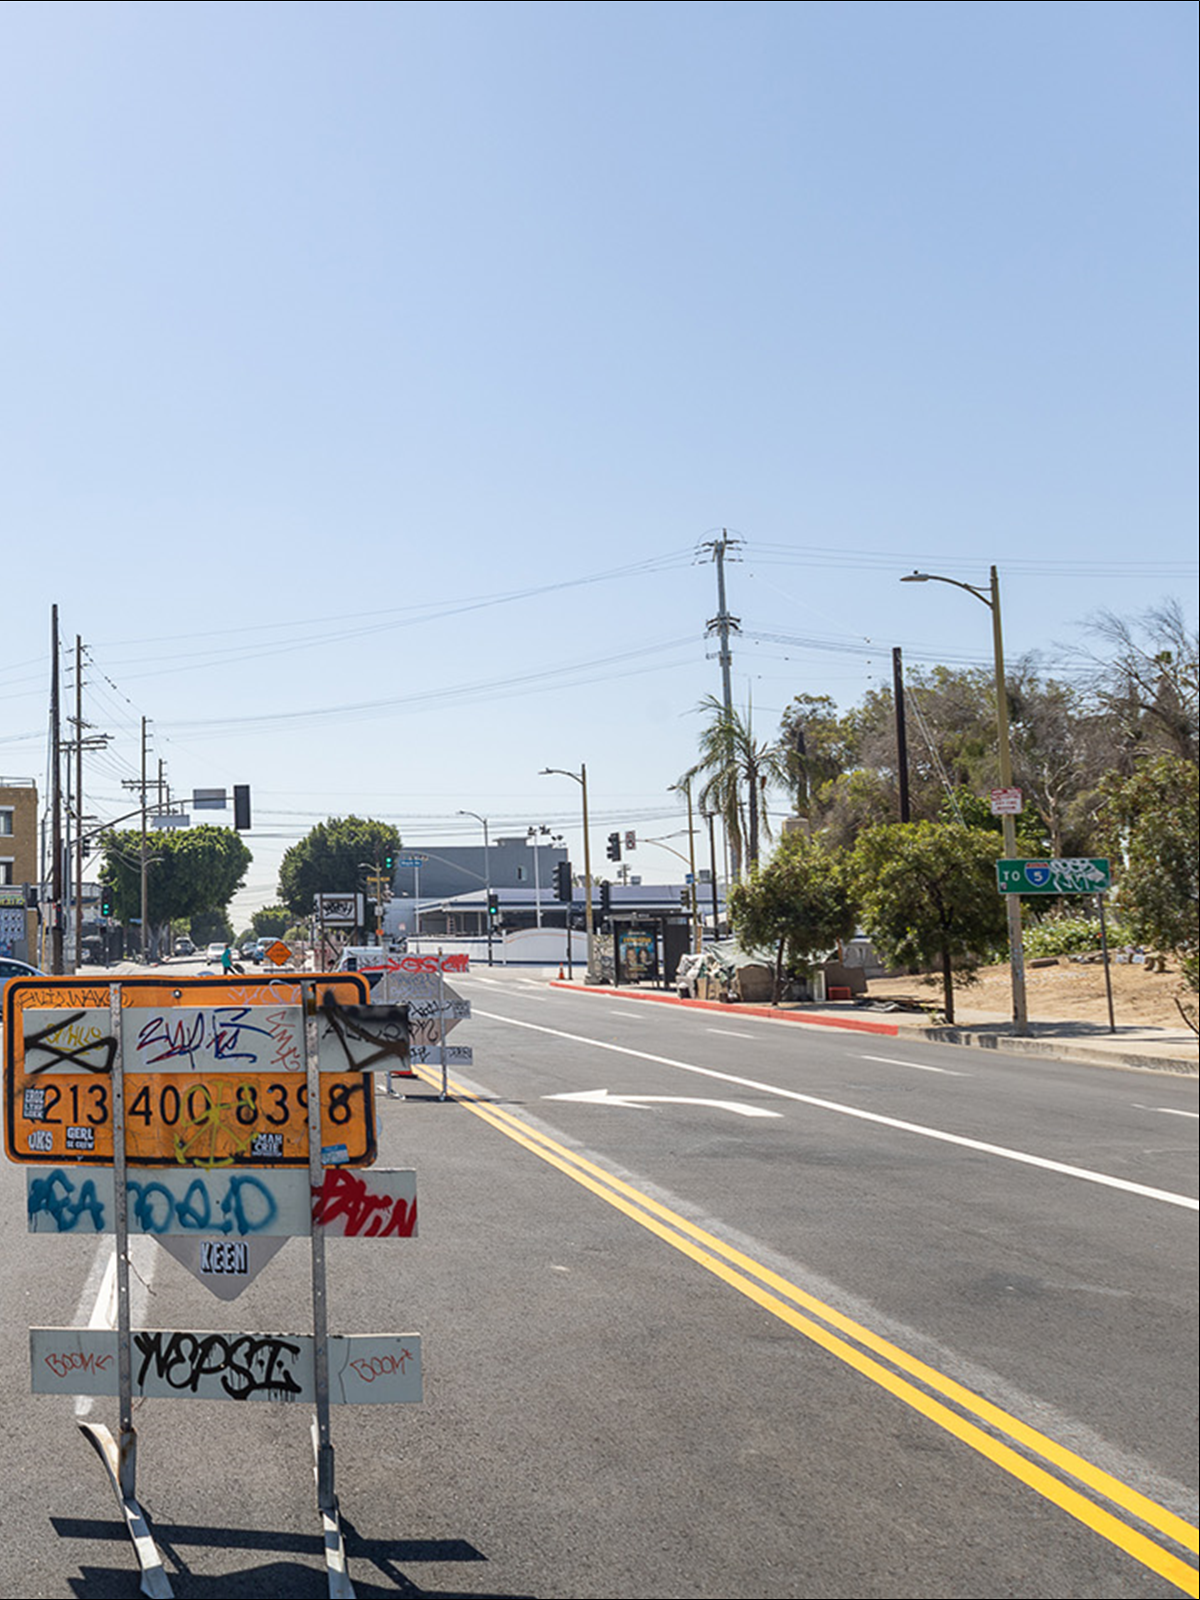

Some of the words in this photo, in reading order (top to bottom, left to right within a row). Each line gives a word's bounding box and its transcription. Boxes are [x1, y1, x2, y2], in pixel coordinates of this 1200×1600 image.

[1003, 870, 1020, 881] TO
[1033, 871, 1043, 882] 5
[30, 1084, 108, 1125] 213
[201, 1242, 248, 1272] KEEN
